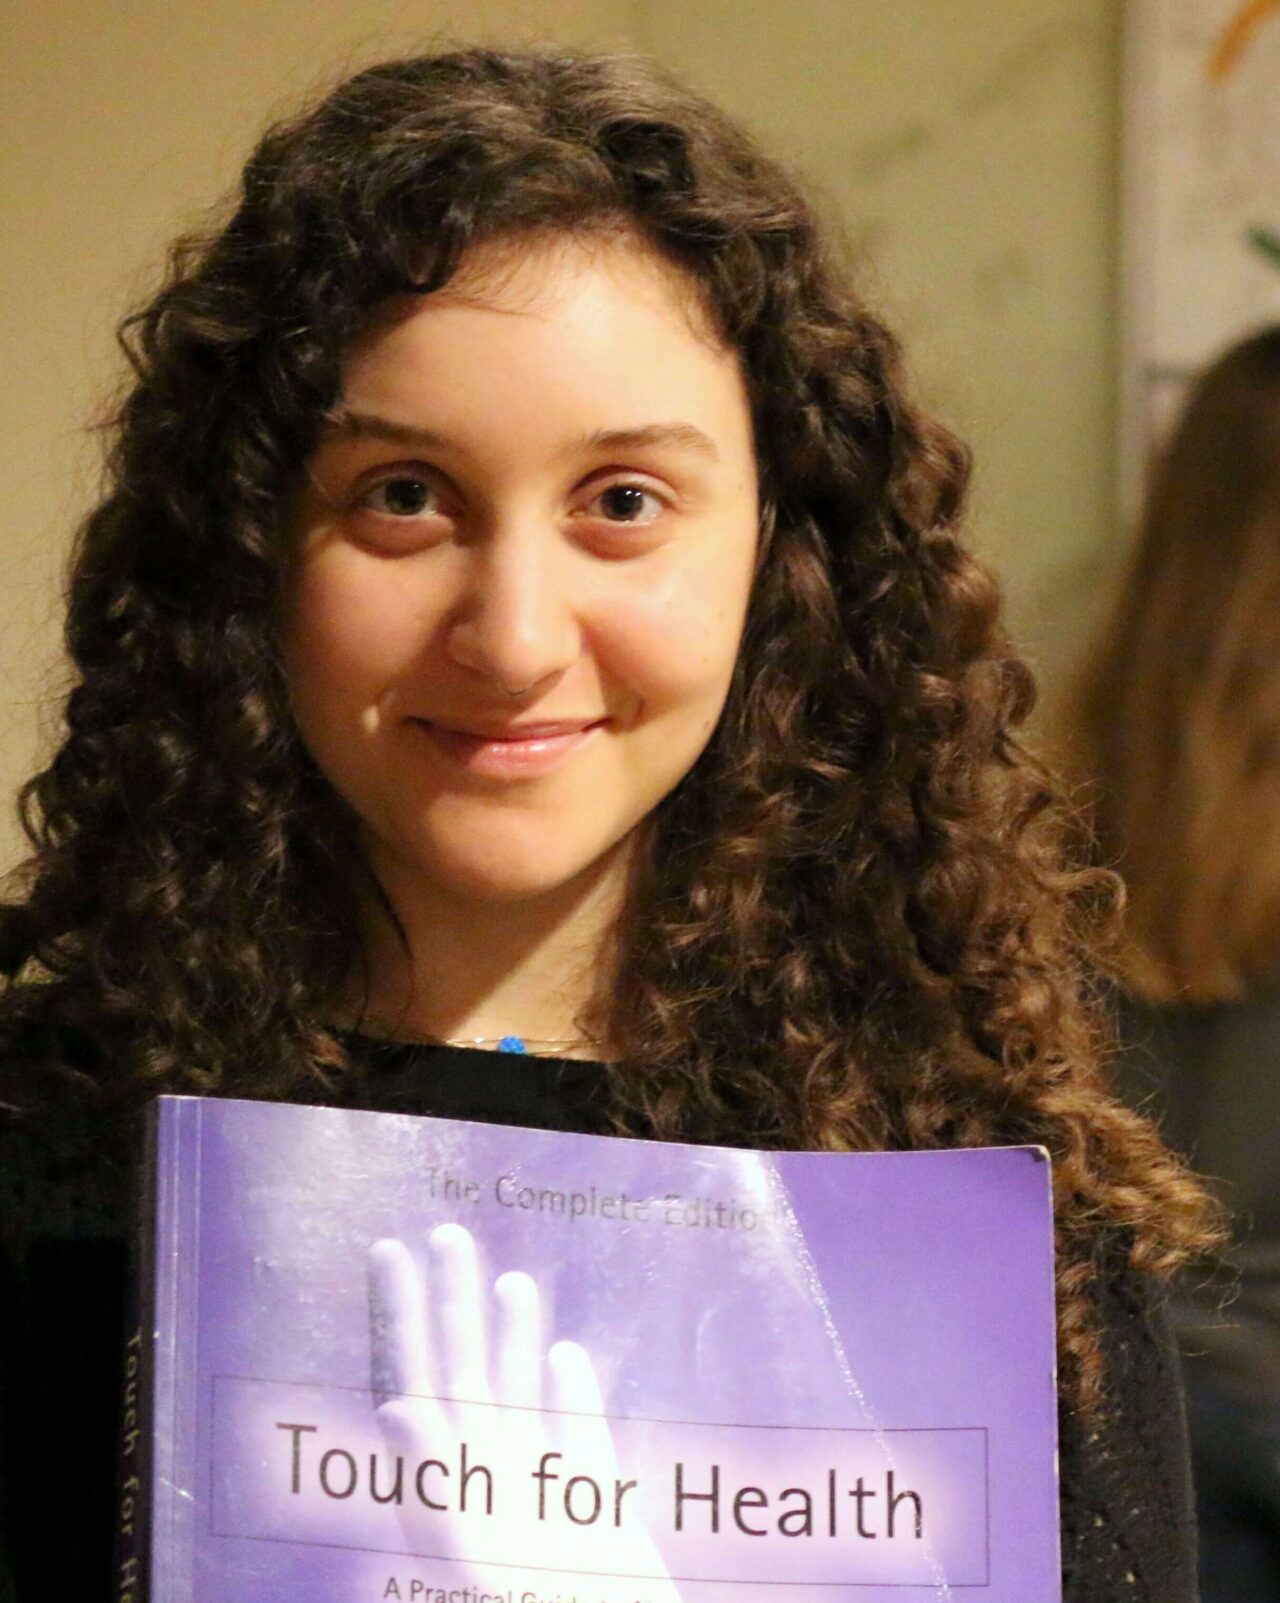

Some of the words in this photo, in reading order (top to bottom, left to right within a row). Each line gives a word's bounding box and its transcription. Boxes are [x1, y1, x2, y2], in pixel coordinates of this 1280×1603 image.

[426, 1166, 480, 1204] The
[495, 1174, 650, 1224] Complete
[664, 1194, 777, 1232] Editio
[122, 1326, 142, 1456] Touch
[121, 1475, 139, 1536] for
[275, 1422, 493, 1516] Touch
[531, 1452, 638, 1528] for
[674, 1462, 923, 1540] Health
[383, 1576, 401, 1601] A
